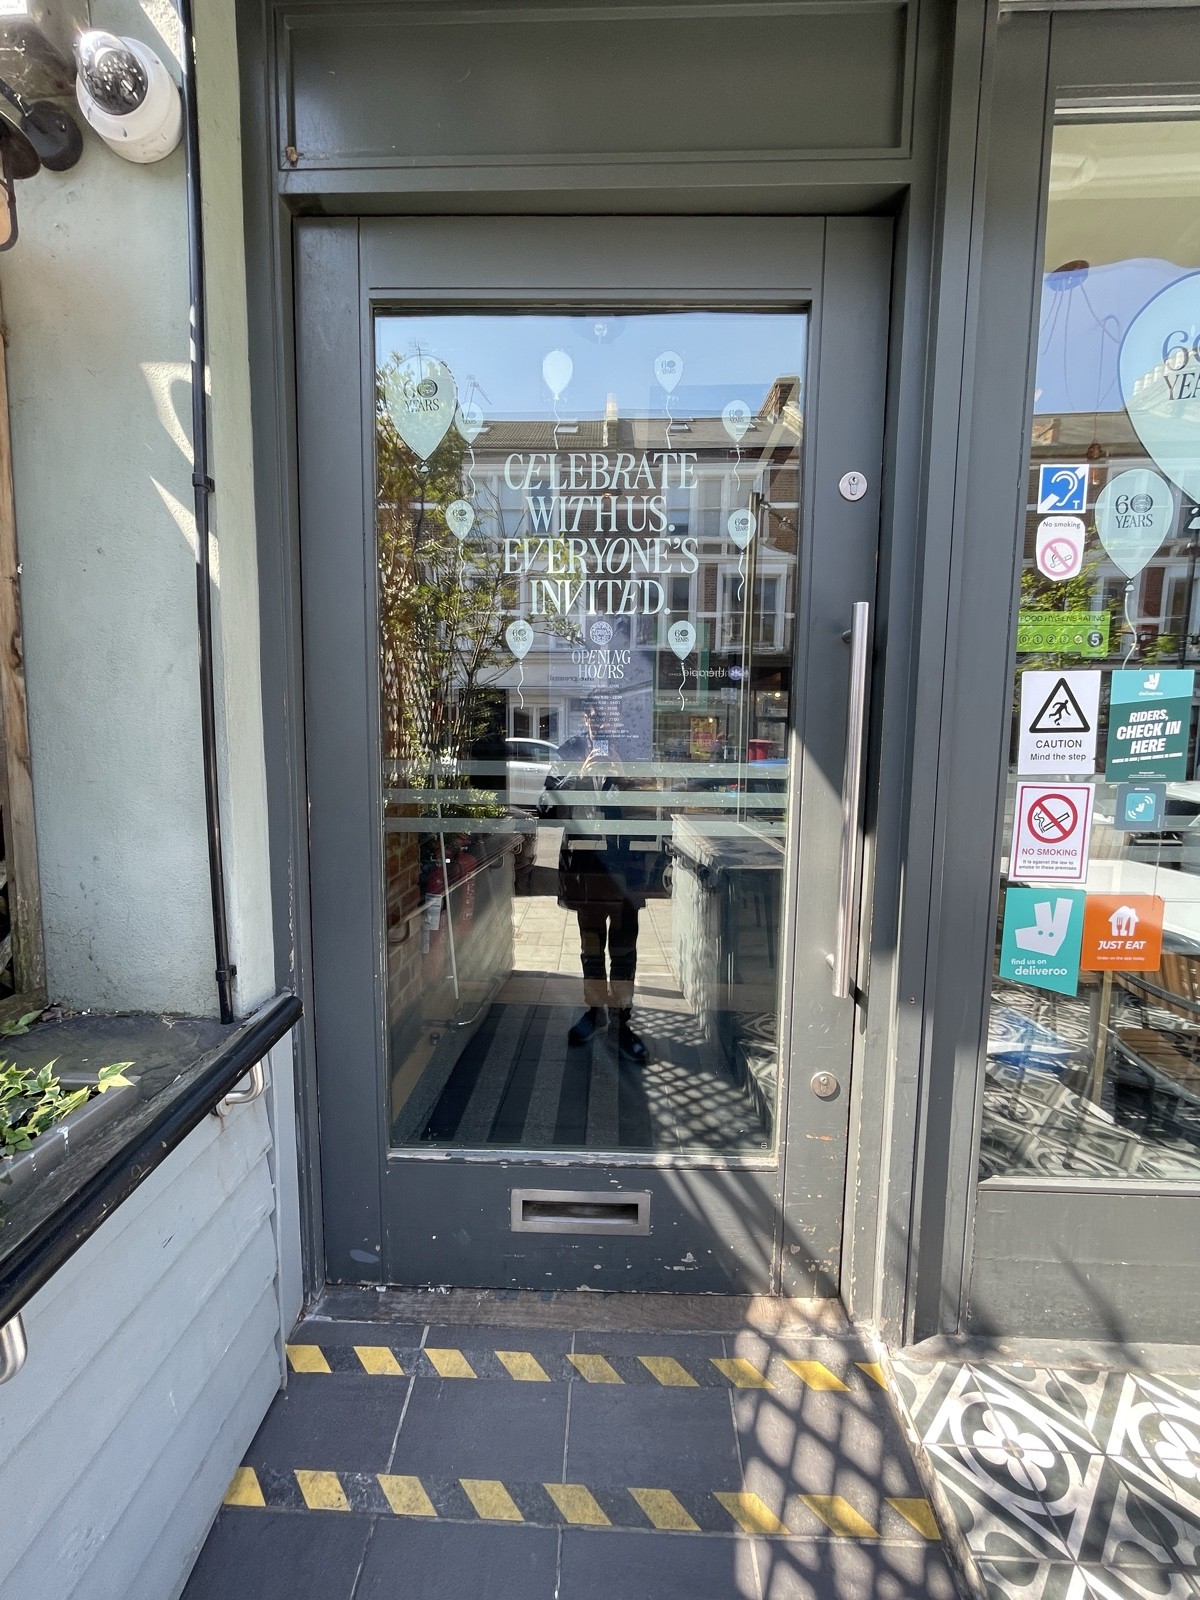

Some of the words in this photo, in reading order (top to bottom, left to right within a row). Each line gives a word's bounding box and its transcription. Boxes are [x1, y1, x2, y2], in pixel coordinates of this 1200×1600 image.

[405, 399, 440, 412] YEARS
[504, 453, 698, 490] CELEBRATE
[1072, 500, 1081, 509] T
[1115, 494, 1154, 515] 60
[525, 496, 619, 532] WITH
[627, 496, 676, 532] US.
[1054, 521, 1081, 530] smoking
[1115, 514, 1154, 529] YEARS
[530, 579, 672, 616] INVITED.
[571, 650, 631, 665] OPENING
[579, 664, 625, 679] HOURS
[1129, 709, 1169, 723] RIDERS,
[1116, 722, 1163, 740] CHECK
[1165, 721, 1182, 736] IN
[1035, 740, 1082, 748] CAUTION
[1130, 738, 1167, 755] HERE
[1068, 753, 1087, 761] step
[1037, 848, 1078, 856] SMOKING
[1097, 941, 1124, 951] JUST
[1125, 941, 1146, 950] EAT
[1014, 966, 1068, 976] deliveroo
